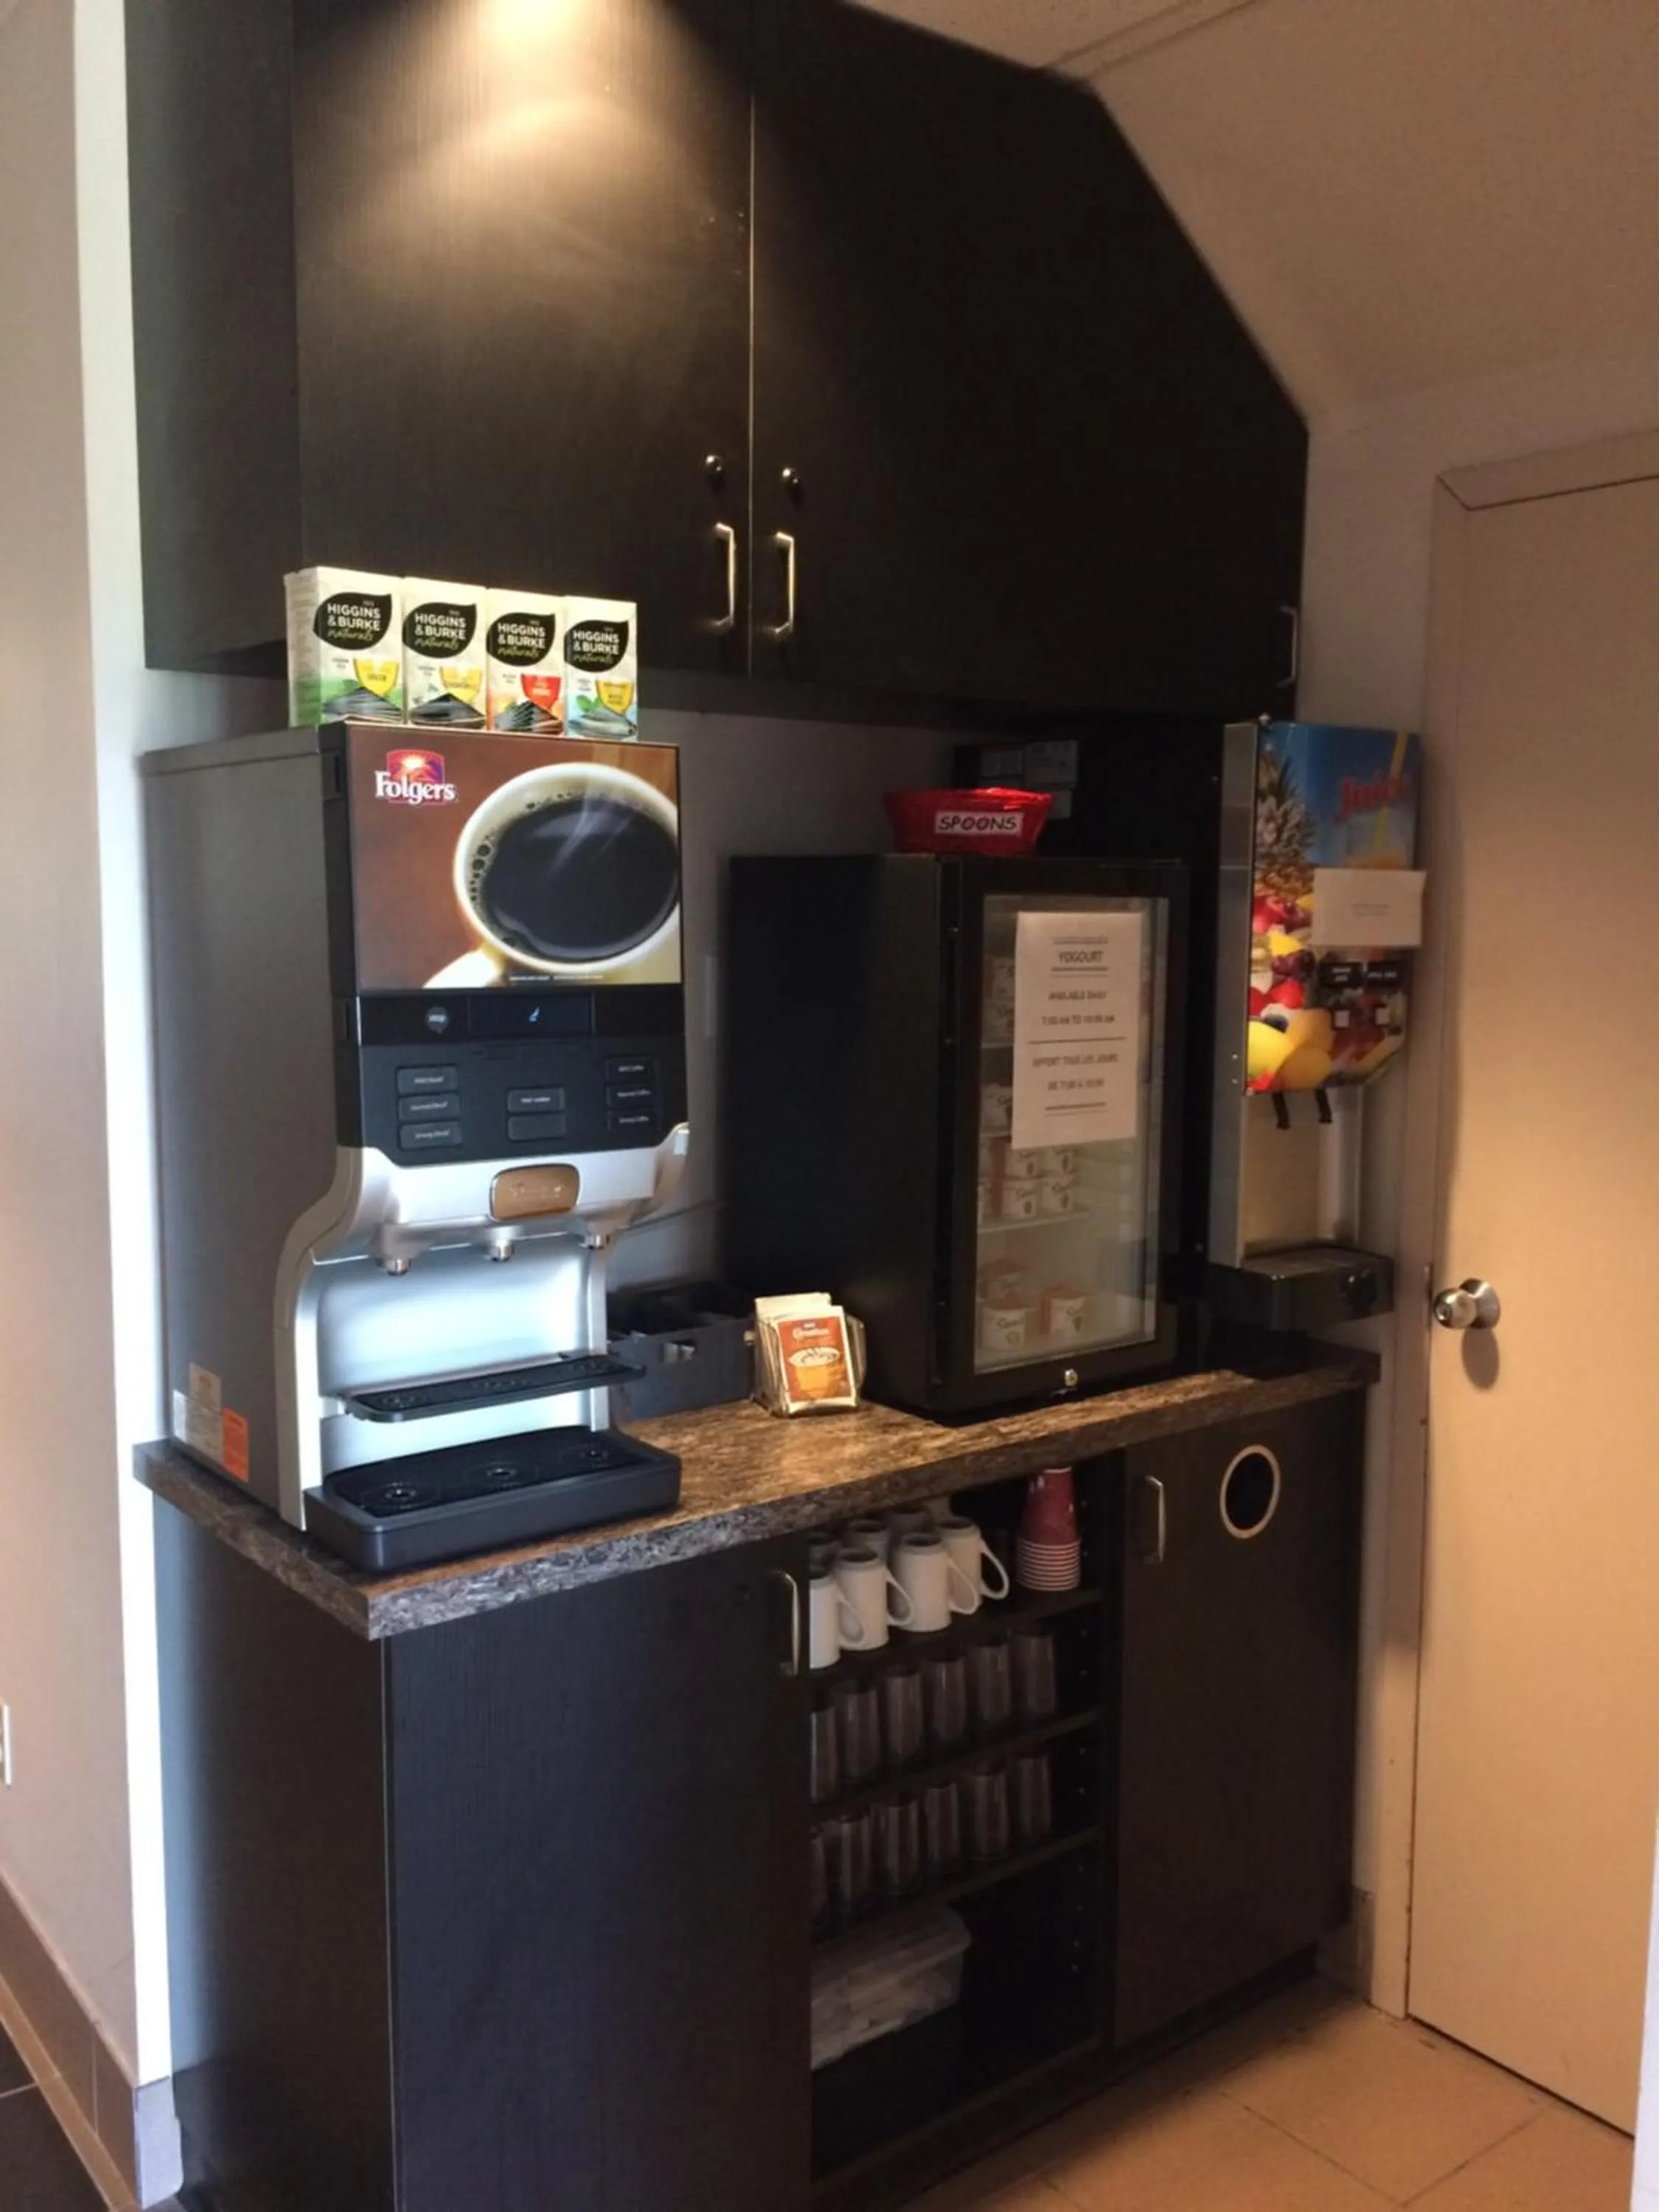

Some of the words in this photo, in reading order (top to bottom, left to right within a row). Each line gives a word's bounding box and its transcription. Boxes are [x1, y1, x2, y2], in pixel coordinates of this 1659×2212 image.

[327, 602, 381, 619] HIGGINS
[414, 613, 466, 628] HIGGINS
[497, 622, 546, 637] HIGGINS
[572, 630, 619, 644] HIGGINS
[374, 770, 456, 804] Folgers
[938, 815, 1018, 831] SPOONS
